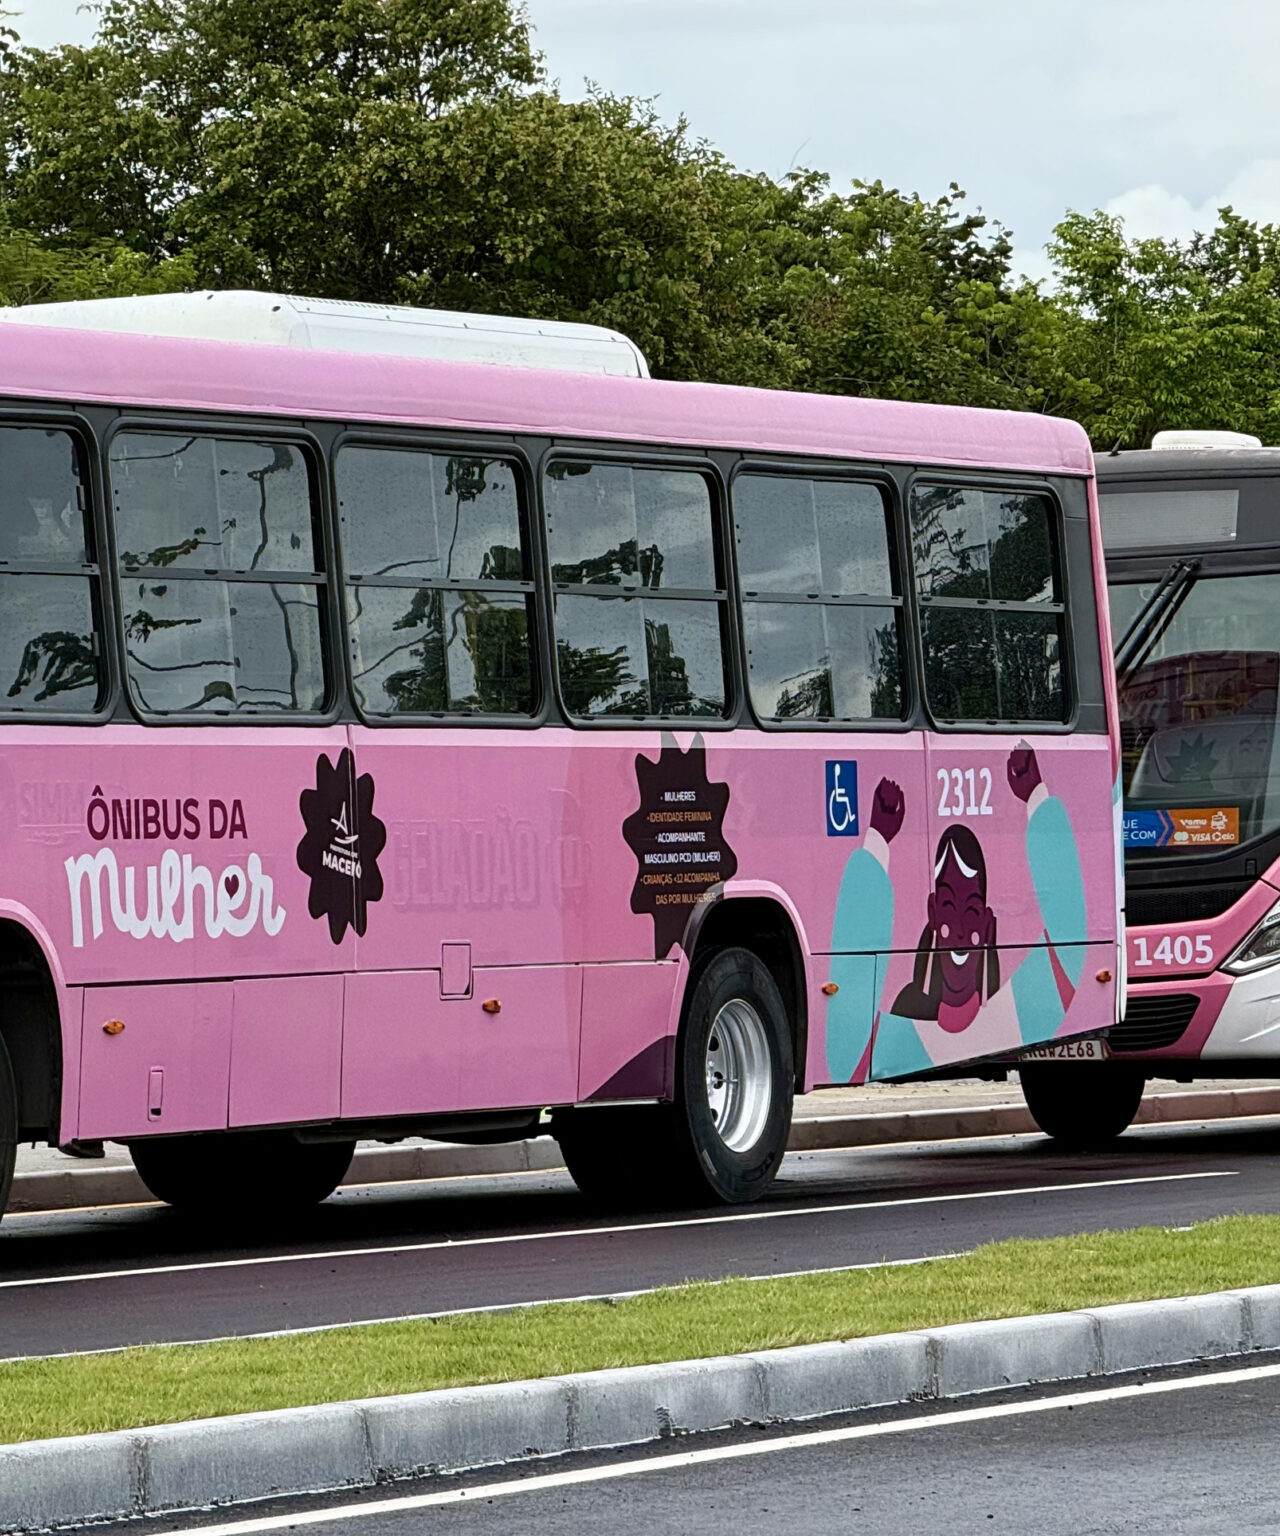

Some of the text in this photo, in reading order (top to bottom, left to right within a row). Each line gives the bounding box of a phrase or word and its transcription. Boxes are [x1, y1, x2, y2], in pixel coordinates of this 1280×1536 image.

[664, 791, 696, 802] MULHERES
[937, 768, 993, 816] 2312
[86, 785, 248, 841] ÔNIBUS DA
[649, 811, 712, 822] IDENTIDADE FEMININA
[657, 832, 706, 843] ACOMPANHANTE
[1130, 830, 1157, 840] COM
[1191, 833, 1211, 842] VISA
[644, 851, 721, 864] MASCULINO PCD (MULHER)
[322, 850, 362, 879] MACEIÓ
[655, 894, 668, 905] DAS
[668, 893, 681, 904] POR
[1133, 935, 1214, 966] 1405
